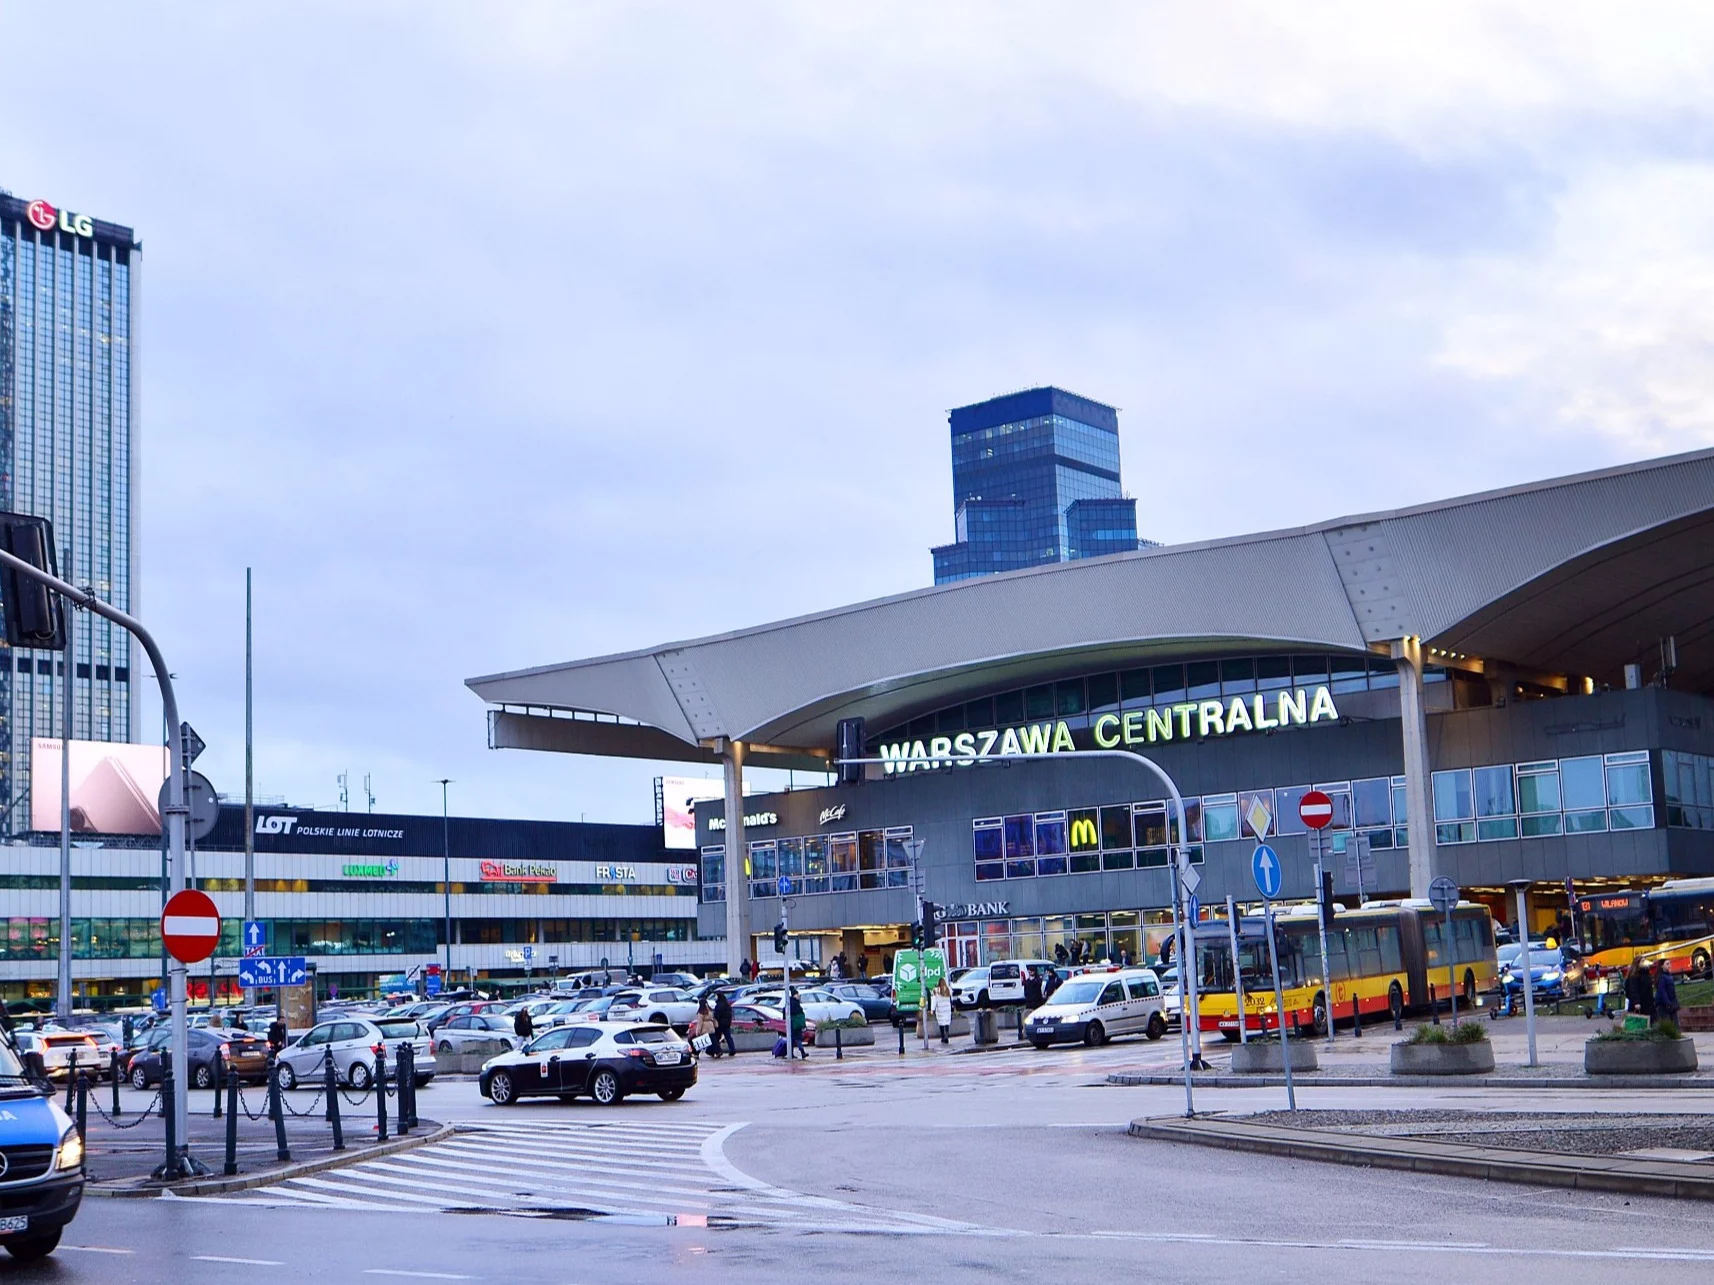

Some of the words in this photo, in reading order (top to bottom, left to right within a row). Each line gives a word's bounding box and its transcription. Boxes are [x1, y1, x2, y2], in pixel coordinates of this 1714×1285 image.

[60, 209, 93, 238] LG
[880, 720, 1076, 774] WARSZAWA
[1094, 685, 1339, 749] CENTRALNA
[255, 815, 298, 835] LOT
[296, 826, 334, 836] POLSKIE
[337, 828, 360, 837] LINIE
[362, 828, 404, 839] LOTNICZE
[708, 812, 778, 831] Mcnald's
[504, 864, 526, 876] Bank
[529, 864, 557, 876] Pekao
[967, 901, 1009, 916] BANK
[245, 947, 265, 956] TAXI
[258, 975, 273, 984] BUS
[1245, 997, 1265, 1007] 2032
